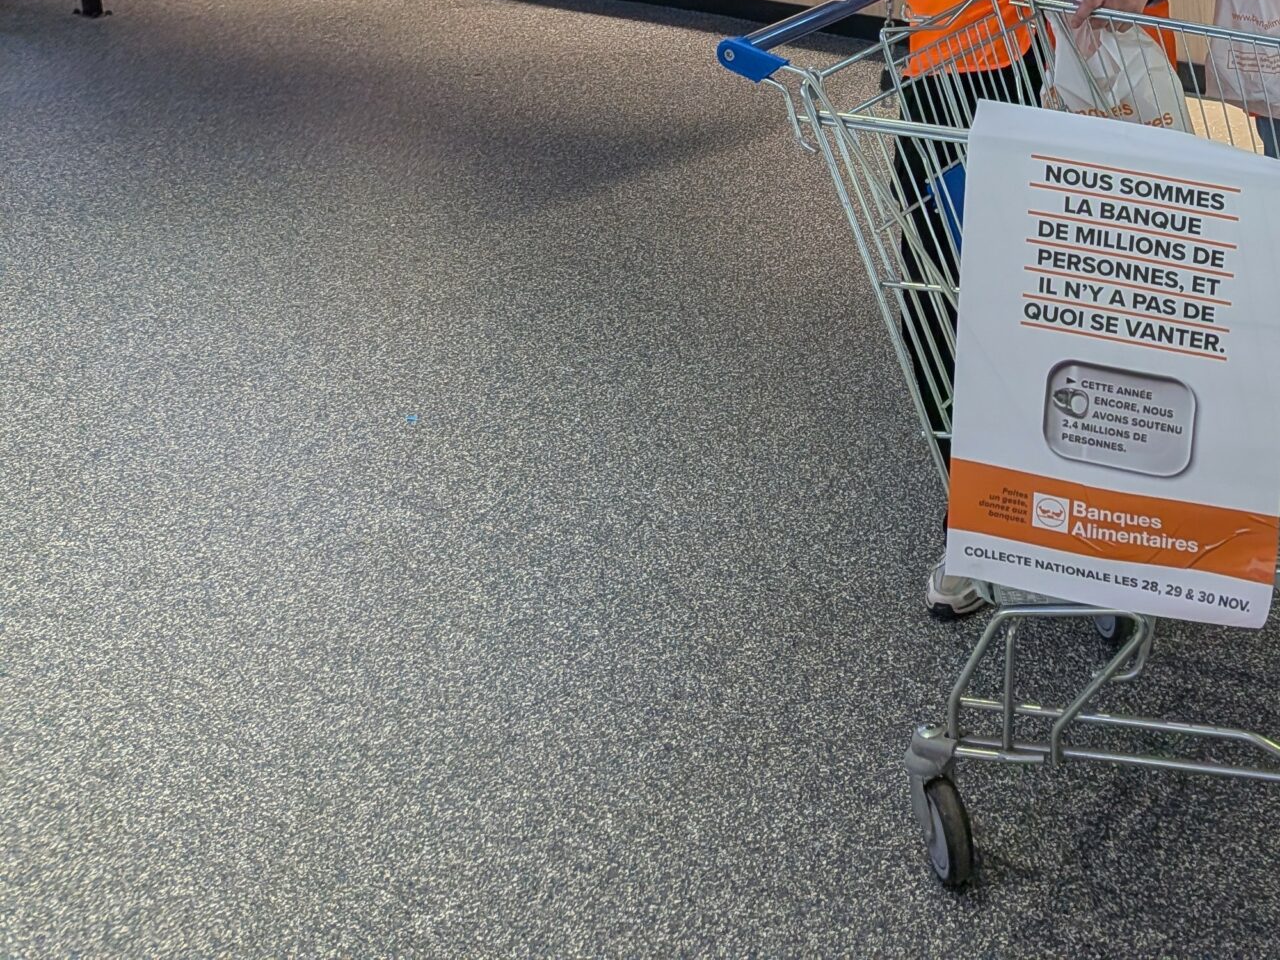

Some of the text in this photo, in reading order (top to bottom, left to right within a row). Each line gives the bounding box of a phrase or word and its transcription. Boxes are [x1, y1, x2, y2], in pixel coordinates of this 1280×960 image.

[1045, 164, 1225, 210] NOUS SOMMES
[1064, 196, 1202, 235] LA BANQUE
[1038, 220, 1225, 268] DE MILLIONS DE
[1037, 248, 1221, 296] PERSONNES, ET
[1038, 276, 1215, 323] IL N'Y A PAS DE
[1023, 302, 1225, 353] QUOI SE VANTER.
[1081, 380, 1152, 400] CETTE ANNÉE
[1092, 410, 1183, 434] AVONS SOUTENU
[1094, 396, 1174, 418] ENCORE, NOUS
[1061, 432, 1127, 453] PERSONNES.
[1081, 422, 1130, 438] MILLIONS
[1133, 432, 1148, 442] DE
[979, 500, 1027, 515] donnez aux
[1002, 497, 1028, 508] geste,
[1003, 487, 1028, 499] Faites
[1072, 500, 1162, 530] Banques
[1071, 521, 1199, 553] Alimentaires
[964, 546, 1250, 613] COLLECTE NATIONALE LES 28, 29 & 30 NOV.
